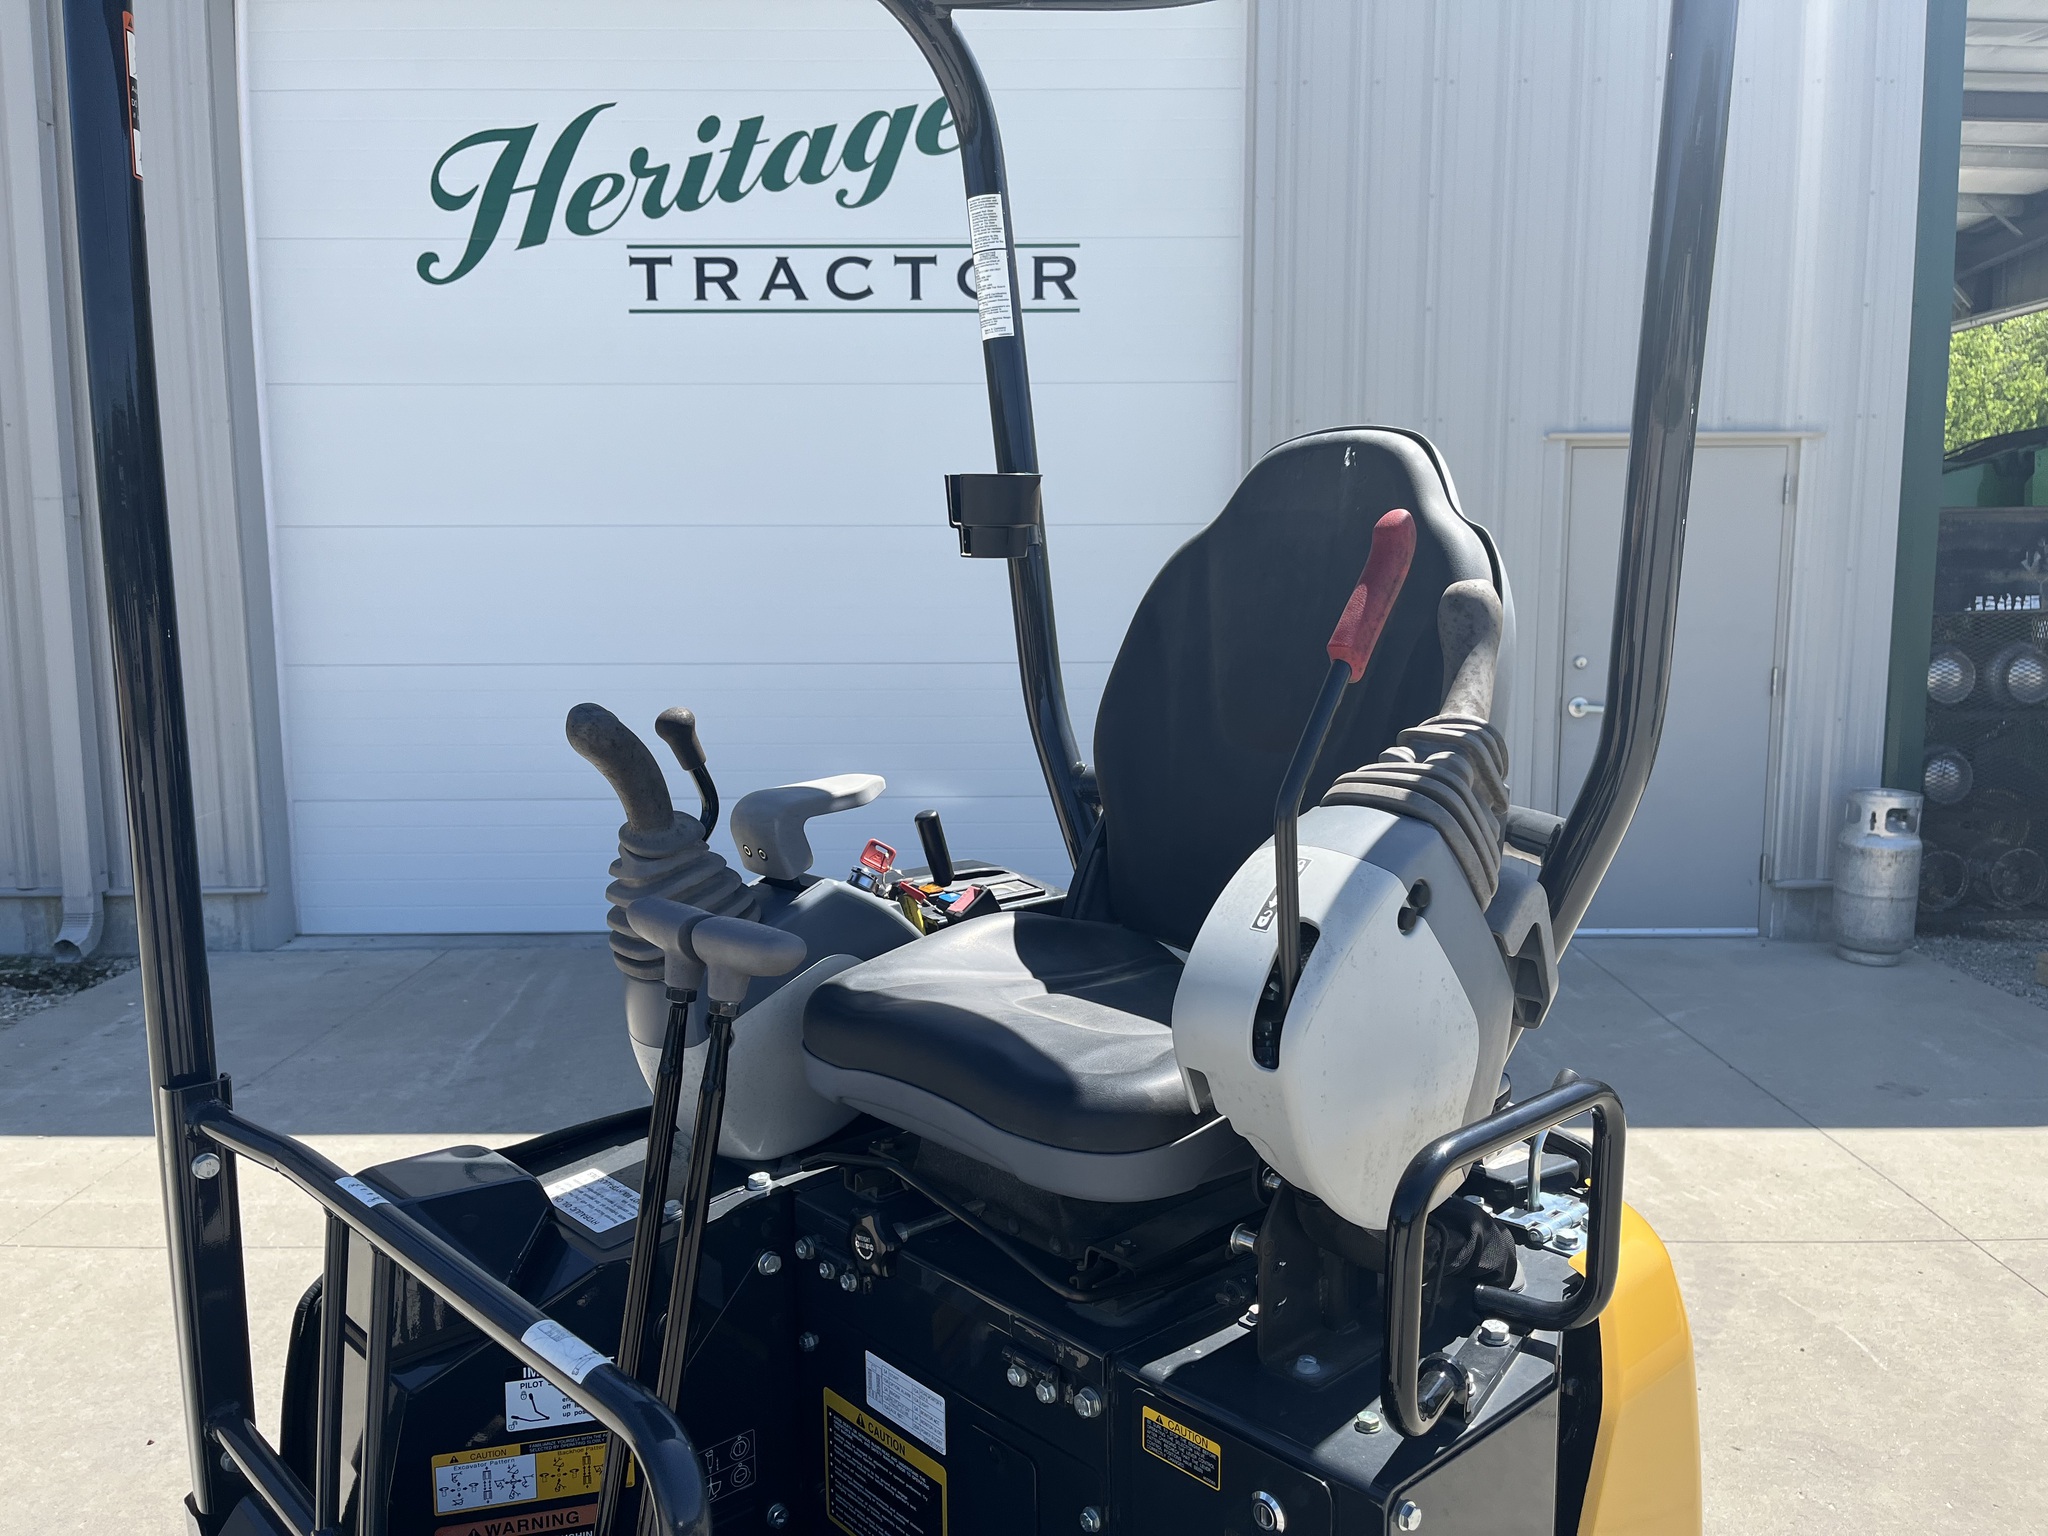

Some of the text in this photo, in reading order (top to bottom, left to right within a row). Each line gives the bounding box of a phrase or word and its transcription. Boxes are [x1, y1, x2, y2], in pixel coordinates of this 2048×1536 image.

[417, 97, 961, 285] Heritage
[520, 1381, 543, 1390] PILOT
[868, 1422, 906, 1456] CAUTION
[1168, 1420, 1209, 1448] CAUTION
[470, 1449, 507, 1461] CAUTION
[585, 1444, 605, 1452] Patter
[453, 1458, 515, 1471] Excavator Pattern
[485, 1511, 579, 1536] WARNING
